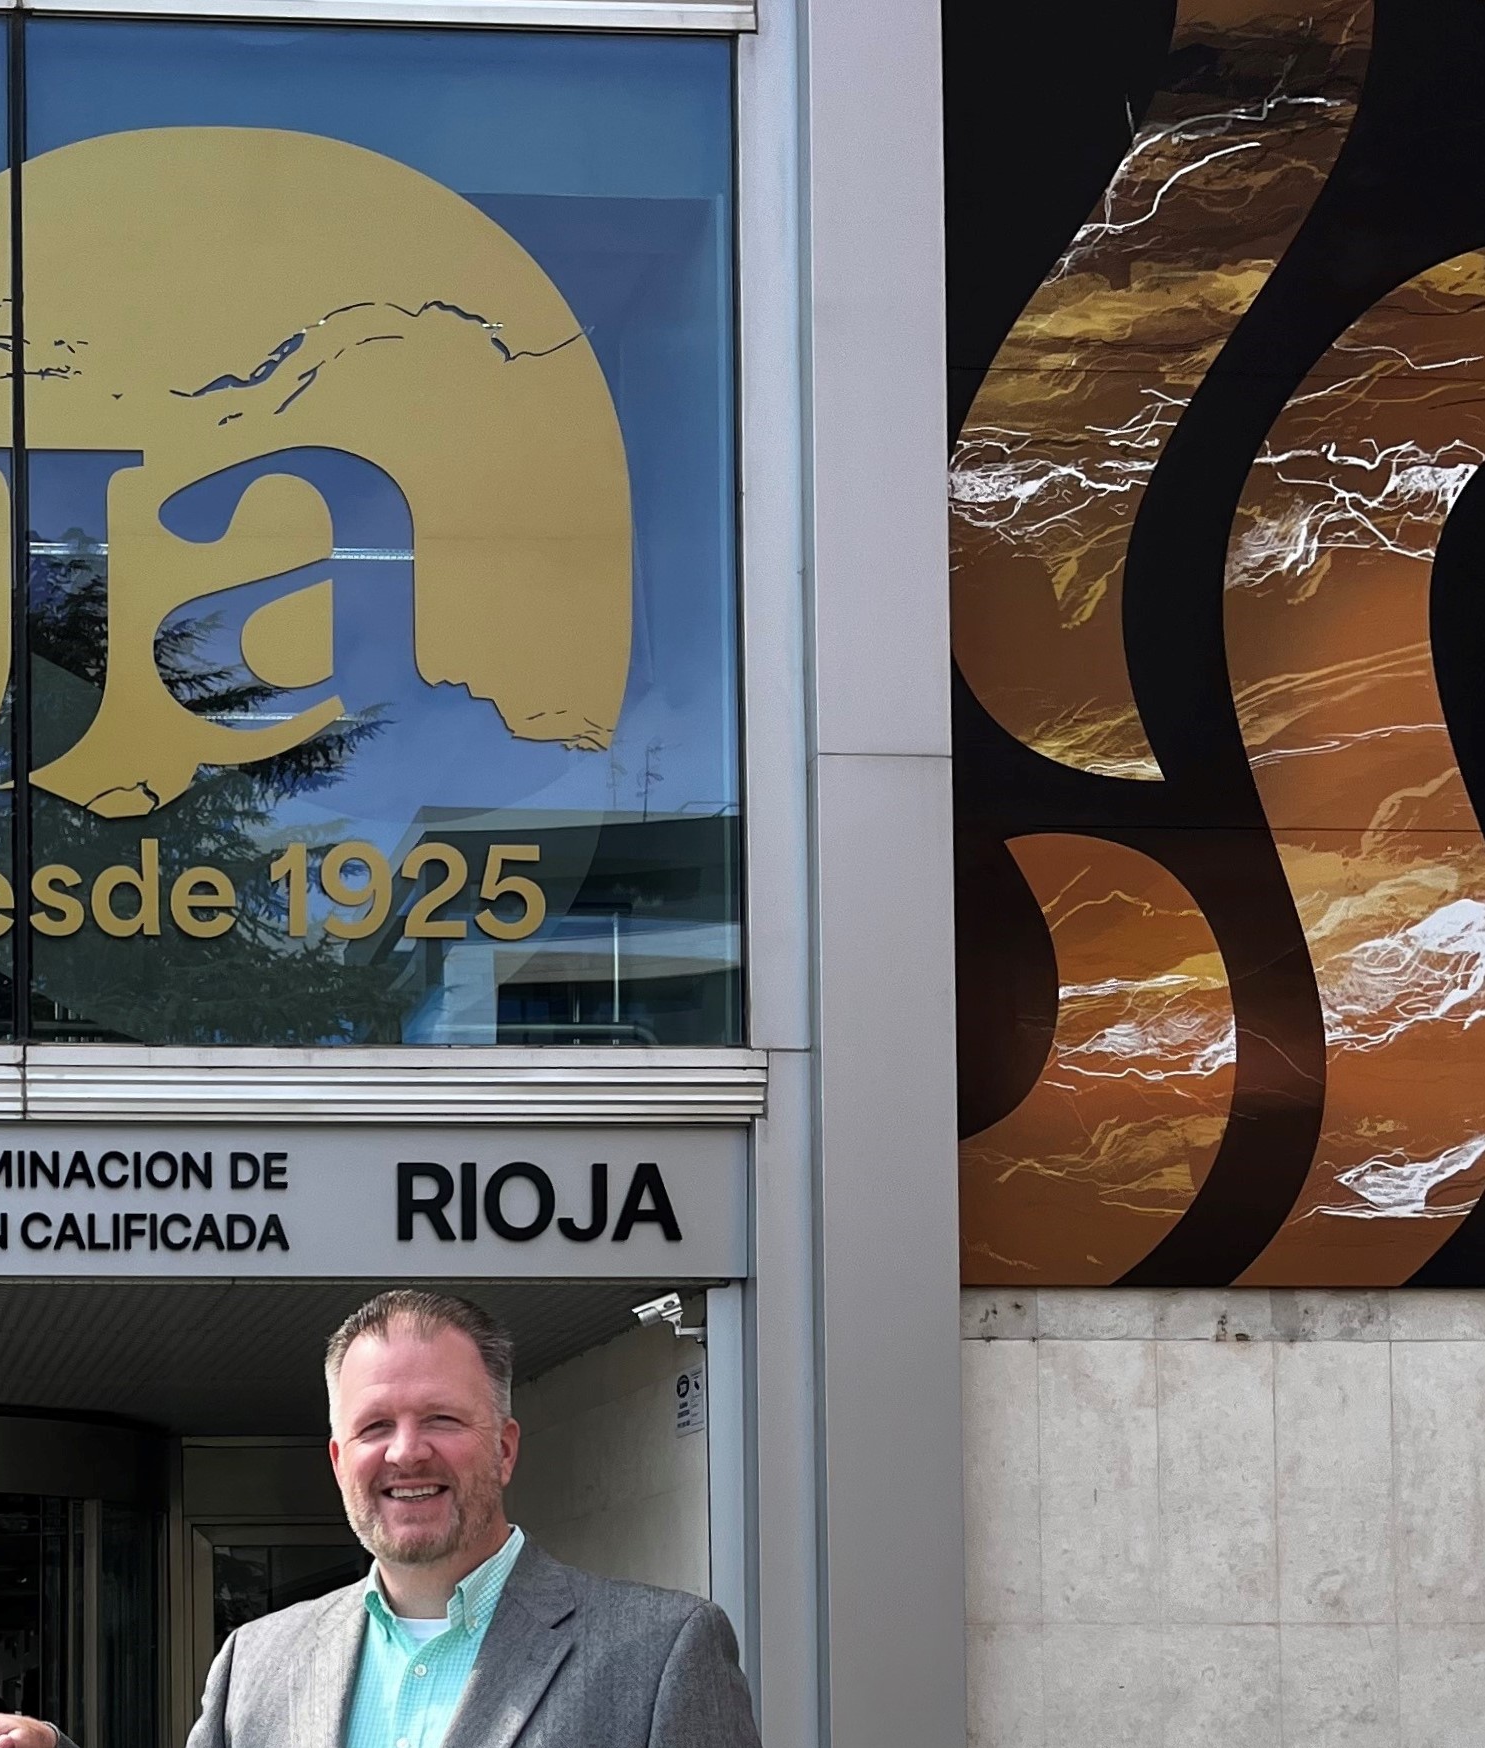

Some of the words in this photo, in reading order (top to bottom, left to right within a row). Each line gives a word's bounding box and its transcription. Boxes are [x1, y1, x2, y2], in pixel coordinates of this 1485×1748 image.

[269, 842, 547, 941] 1925
[229, 1151, 289, 1191] DE
[396, 1161, 682, 1243] RIOJA
[21, 1210, 290, 1252] CALIFICADA
